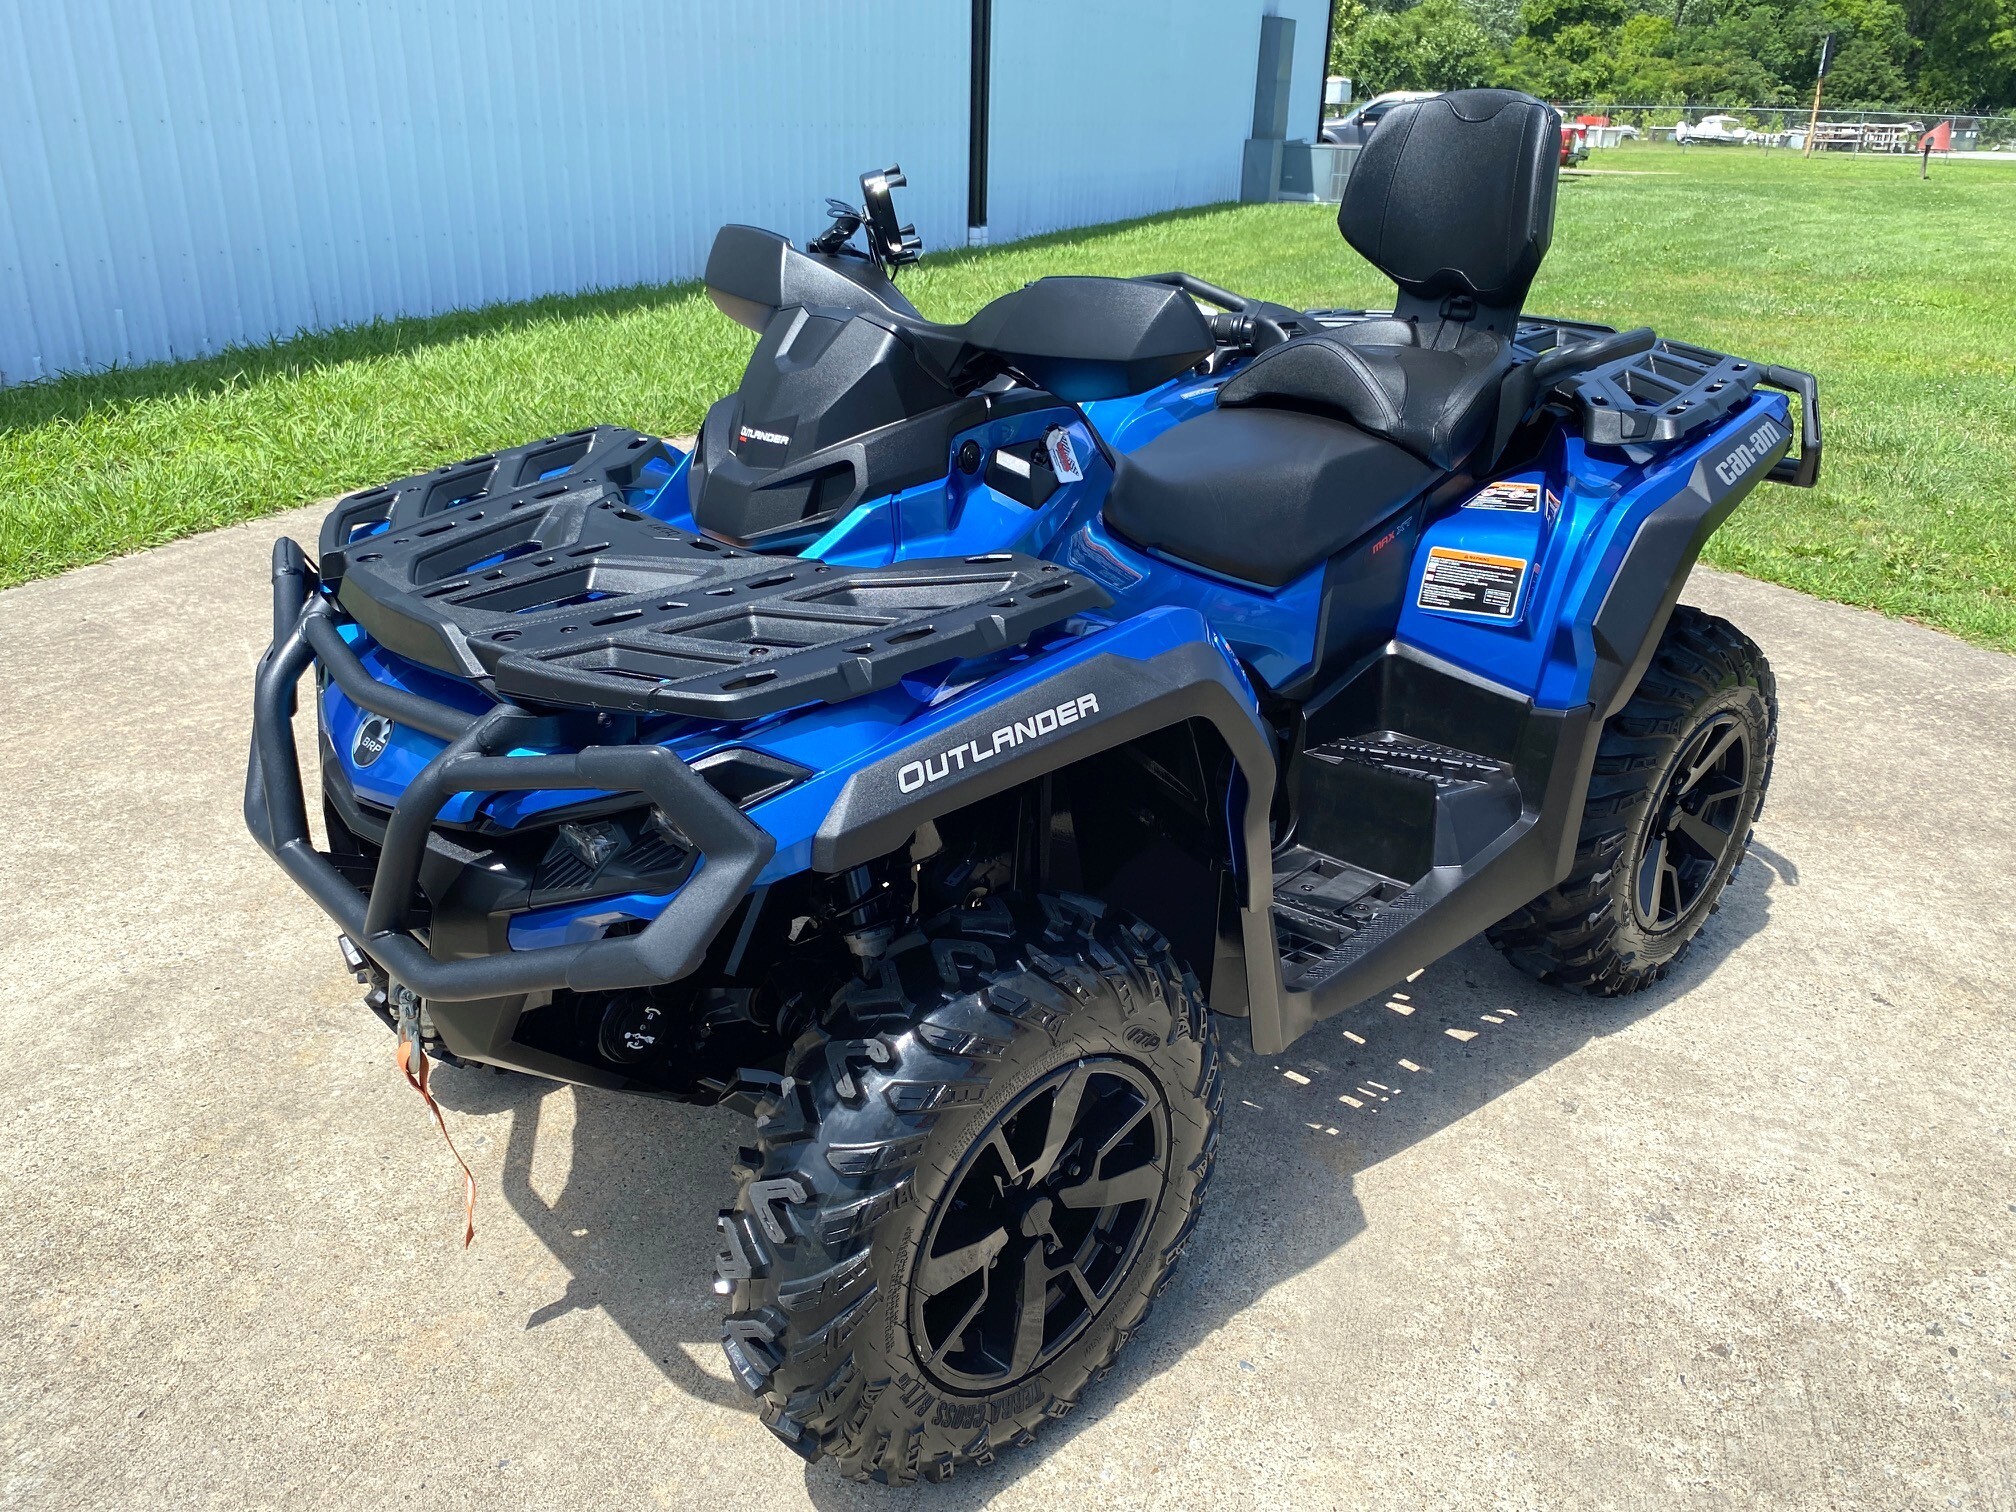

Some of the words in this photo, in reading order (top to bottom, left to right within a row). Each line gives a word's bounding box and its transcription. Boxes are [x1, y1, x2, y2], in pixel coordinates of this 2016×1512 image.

[1715, 421, 1781, 486] can-am
[1372, 530, 1395, 554] MAX
[362, 737, 382, 752] BRP
[898, 693, 1100, 794] OUTLANDER
[1127, 1026, 1161, 1048] ITP
[932, 1400, 987, 1430] CROSS
[991, 1379, 1046, 1424] TERRA
